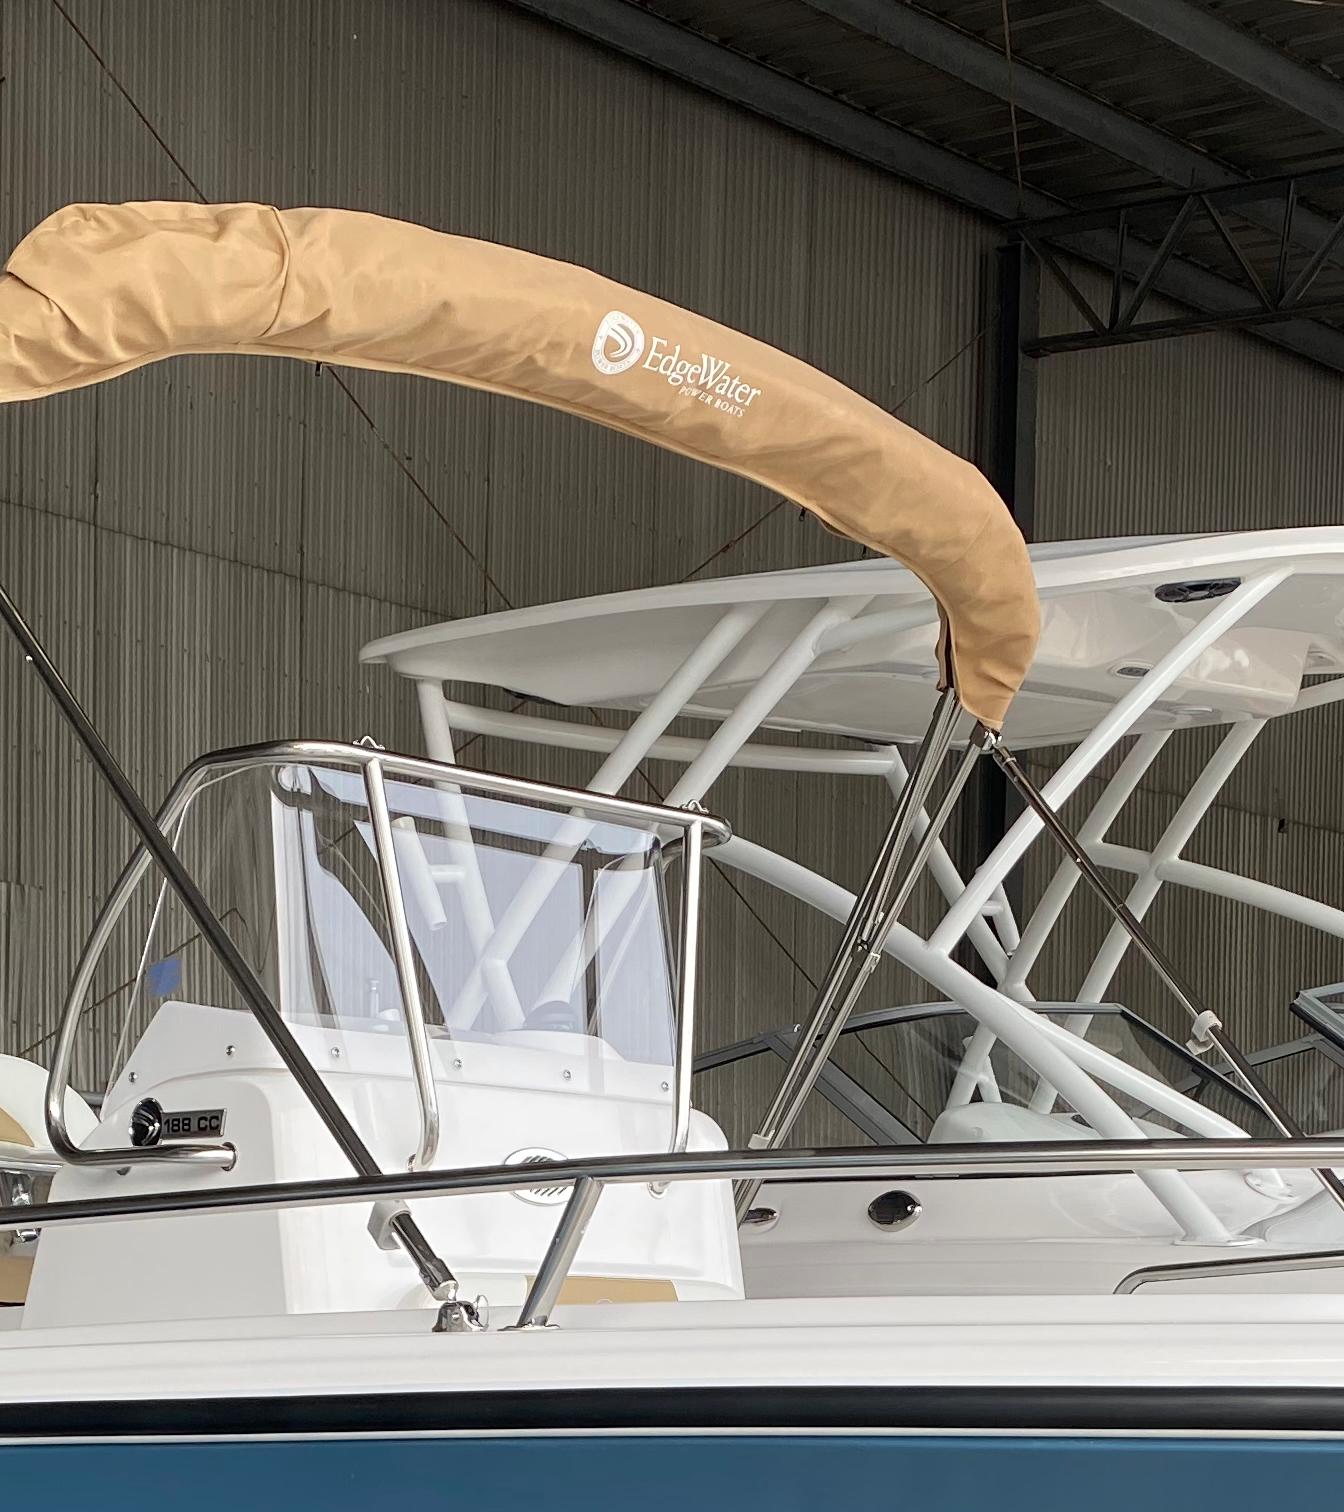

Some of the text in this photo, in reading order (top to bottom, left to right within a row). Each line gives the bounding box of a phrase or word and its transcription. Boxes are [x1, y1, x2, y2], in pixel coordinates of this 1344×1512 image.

[642, 336, 762, 407] EdgeWater
[678, 385, 745, 418] POWER BOATS
[163, 1115, 220, 1133] 188 CC
